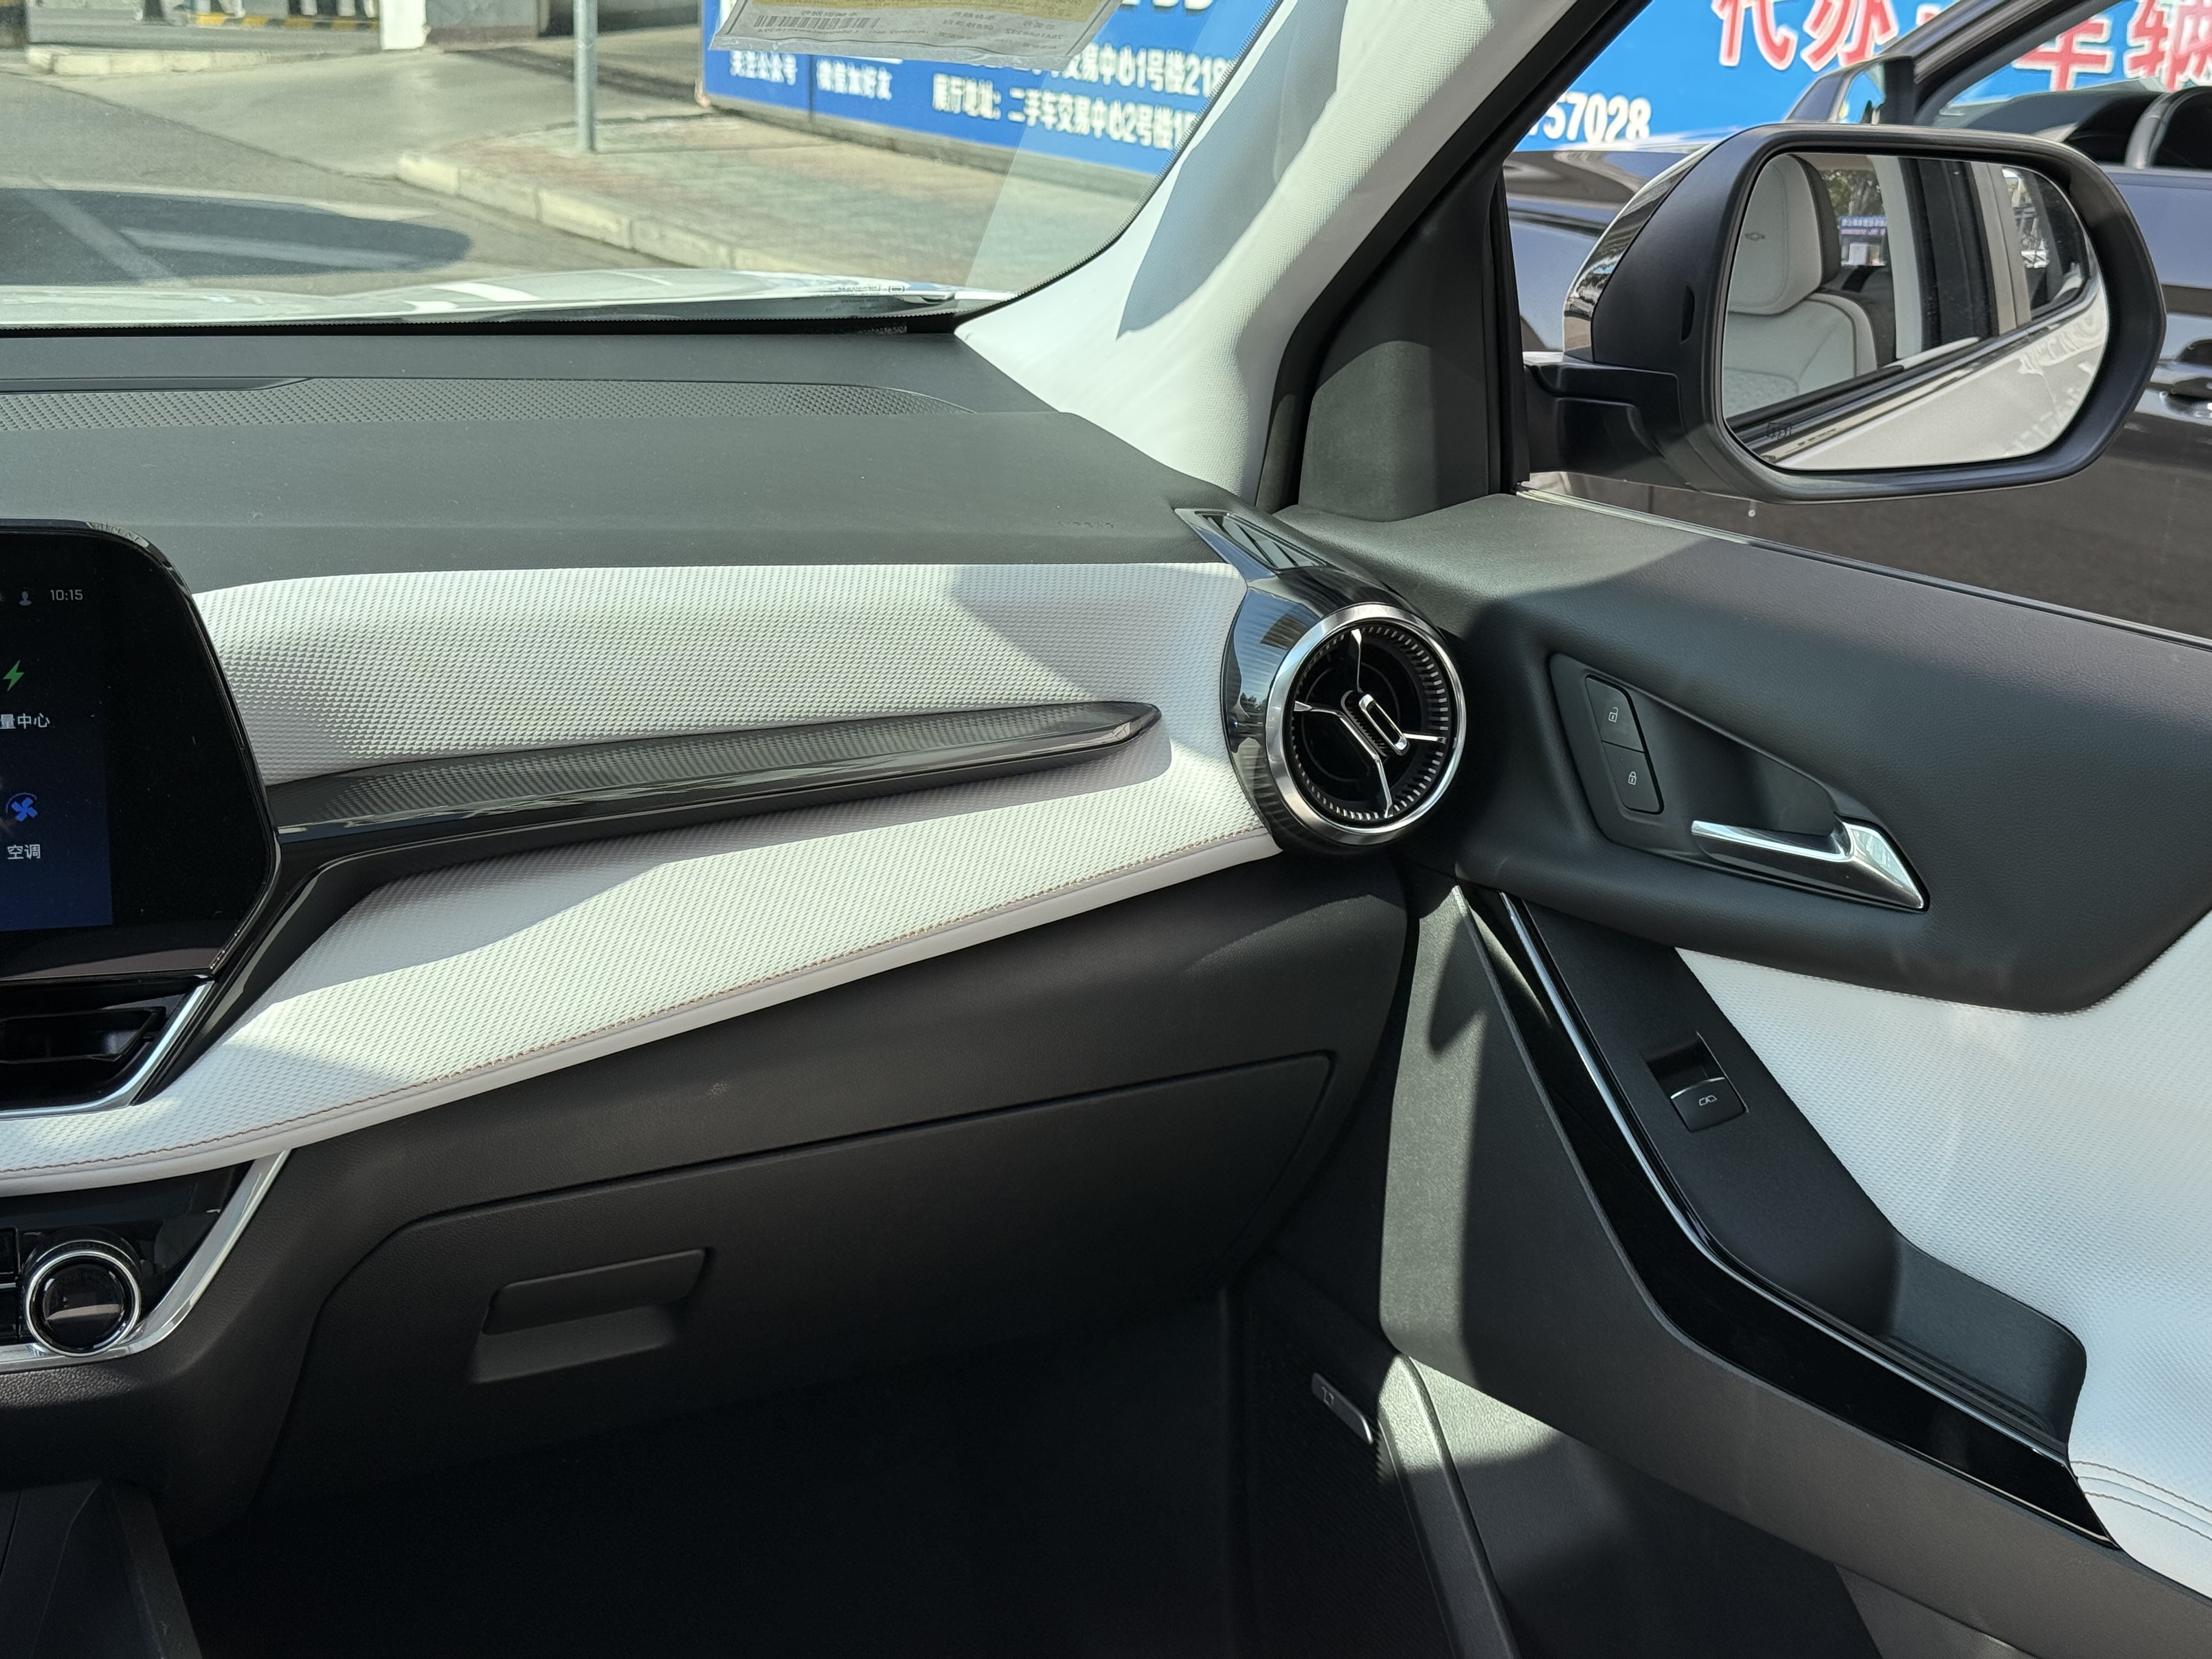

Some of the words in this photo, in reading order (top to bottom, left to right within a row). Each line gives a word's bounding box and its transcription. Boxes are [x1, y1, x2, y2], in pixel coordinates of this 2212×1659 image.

[1530, 91, 1651, 143] 57028
[50, 589, 83, 601] 10:15
[7, 844, 41, 860] 空调
